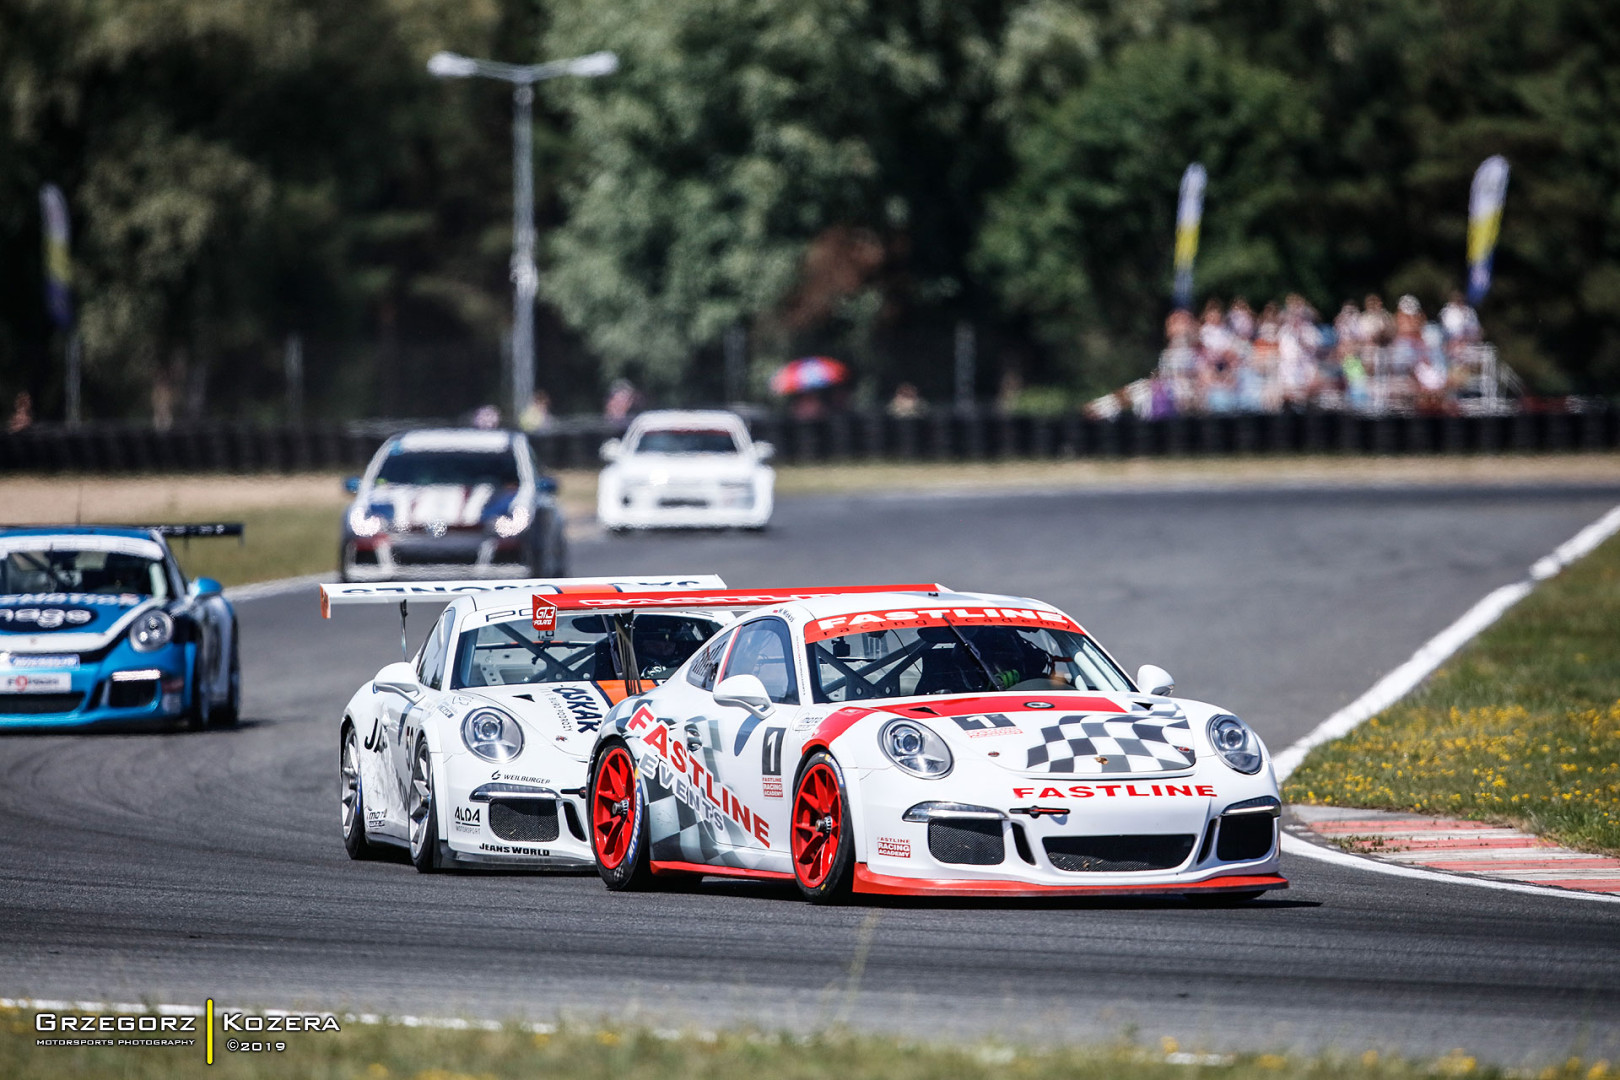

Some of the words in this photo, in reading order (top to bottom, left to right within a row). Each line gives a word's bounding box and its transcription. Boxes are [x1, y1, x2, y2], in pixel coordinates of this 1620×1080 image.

[536, 606, 555, 620] GT3
[817, 609, 1068, 631] FASTLINE
[823, 618, 927, 636] racing
[966, 715, 997, 728] 1
[767, 730, 779, 772] 1
[503, 774, 551, 785] WEILBURGER
[627, 704, 771, 849] FASTLINE
[637, 752, 726, 832] EVENTS
[1013, 784, 1217, 800] FASTLINE
[454, 805, 481, 823] ALDA
[628, 792, 642, 859] MICHELIN
[479, 842, 511, 854] JEANS
[511, 846, 550, 856] WORLD
[878, 842, 910, 852] RACING
[878, 849, 910, 857] ACADEMY
